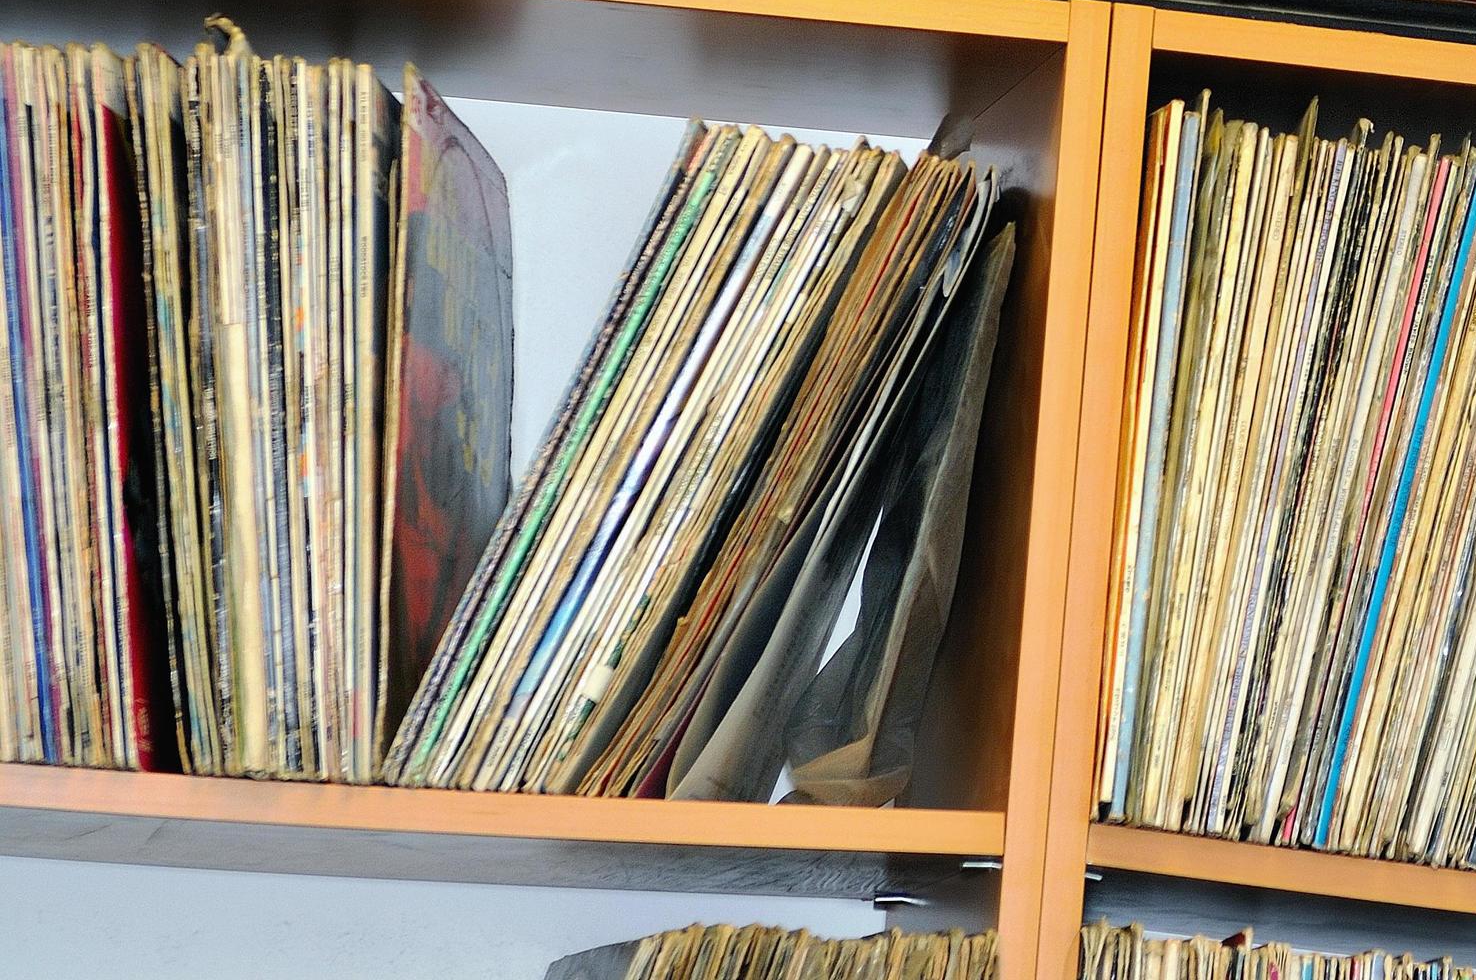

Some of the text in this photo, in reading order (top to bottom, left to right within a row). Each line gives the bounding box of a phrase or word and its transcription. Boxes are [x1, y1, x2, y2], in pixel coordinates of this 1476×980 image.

[1272, 210, 1283, 241] STEREO
[1417, 272, 1430, 306] MACHINE
[1408, 320, 1420, 344] JAMES
